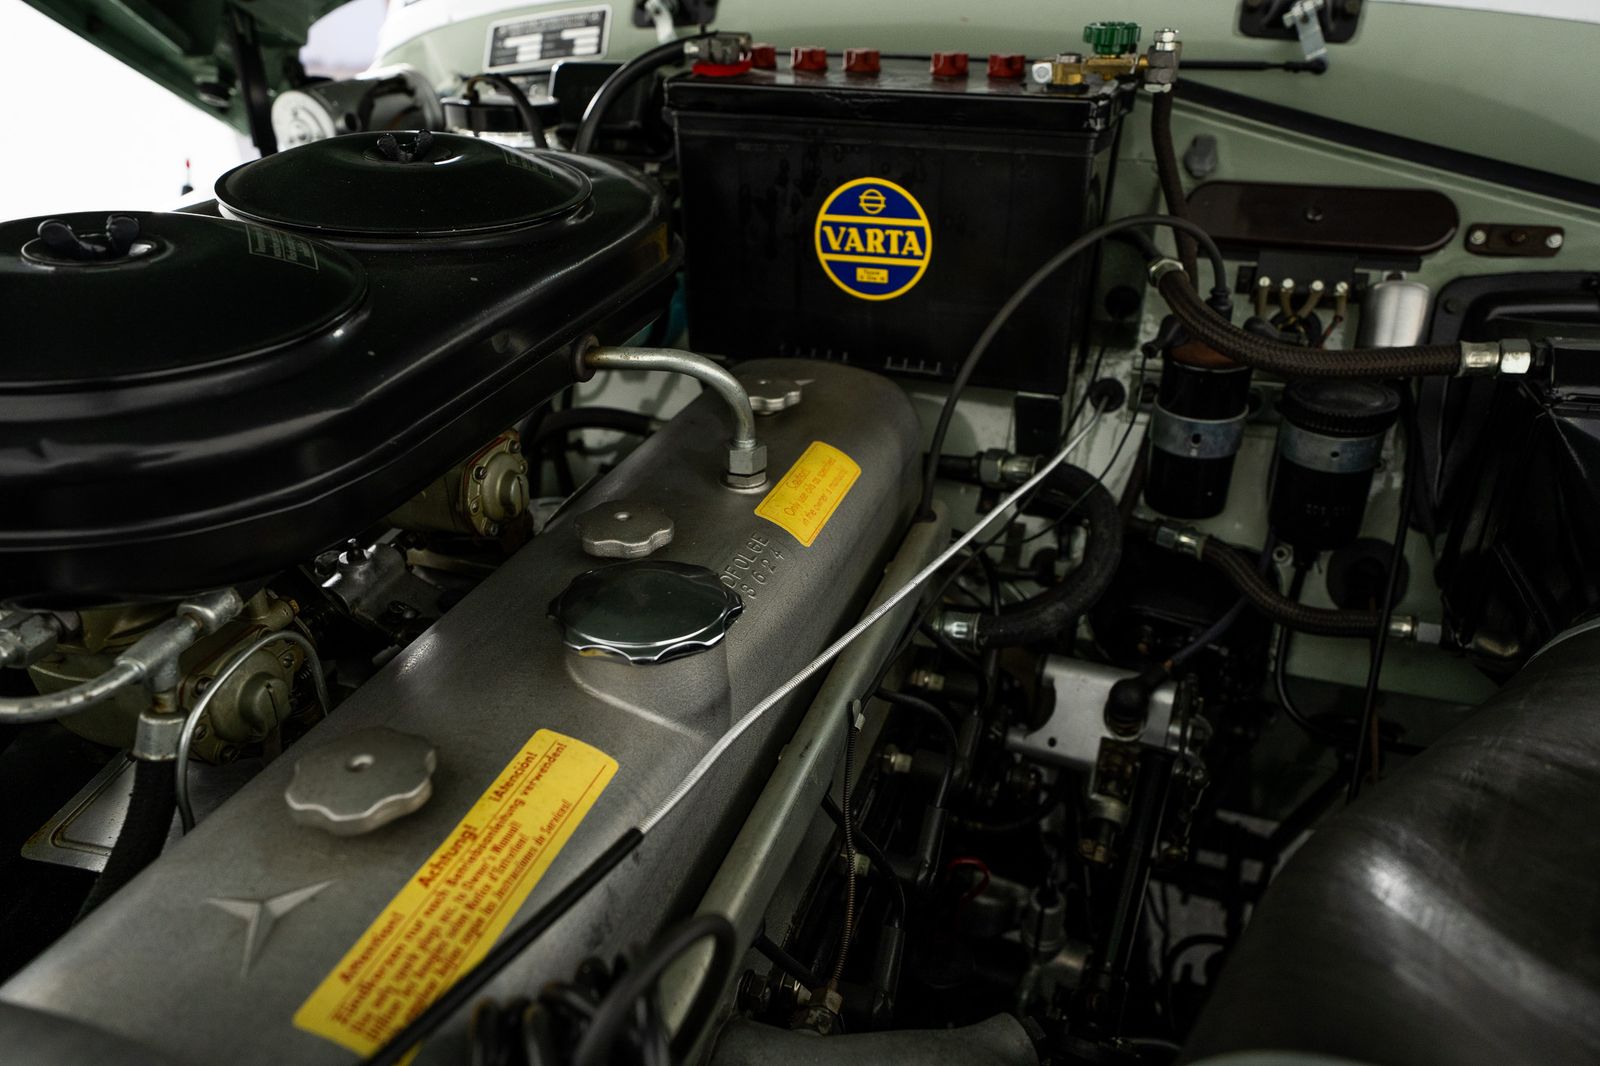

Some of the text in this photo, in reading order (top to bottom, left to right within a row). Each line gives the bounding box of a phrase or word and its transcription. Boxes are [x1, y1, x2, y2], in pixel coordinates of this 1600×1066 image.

[822, 225, 924, 257] VARTA
[517, 741, 568, 796] verwenden!
[415, 822, 481, 891] Achtung!
